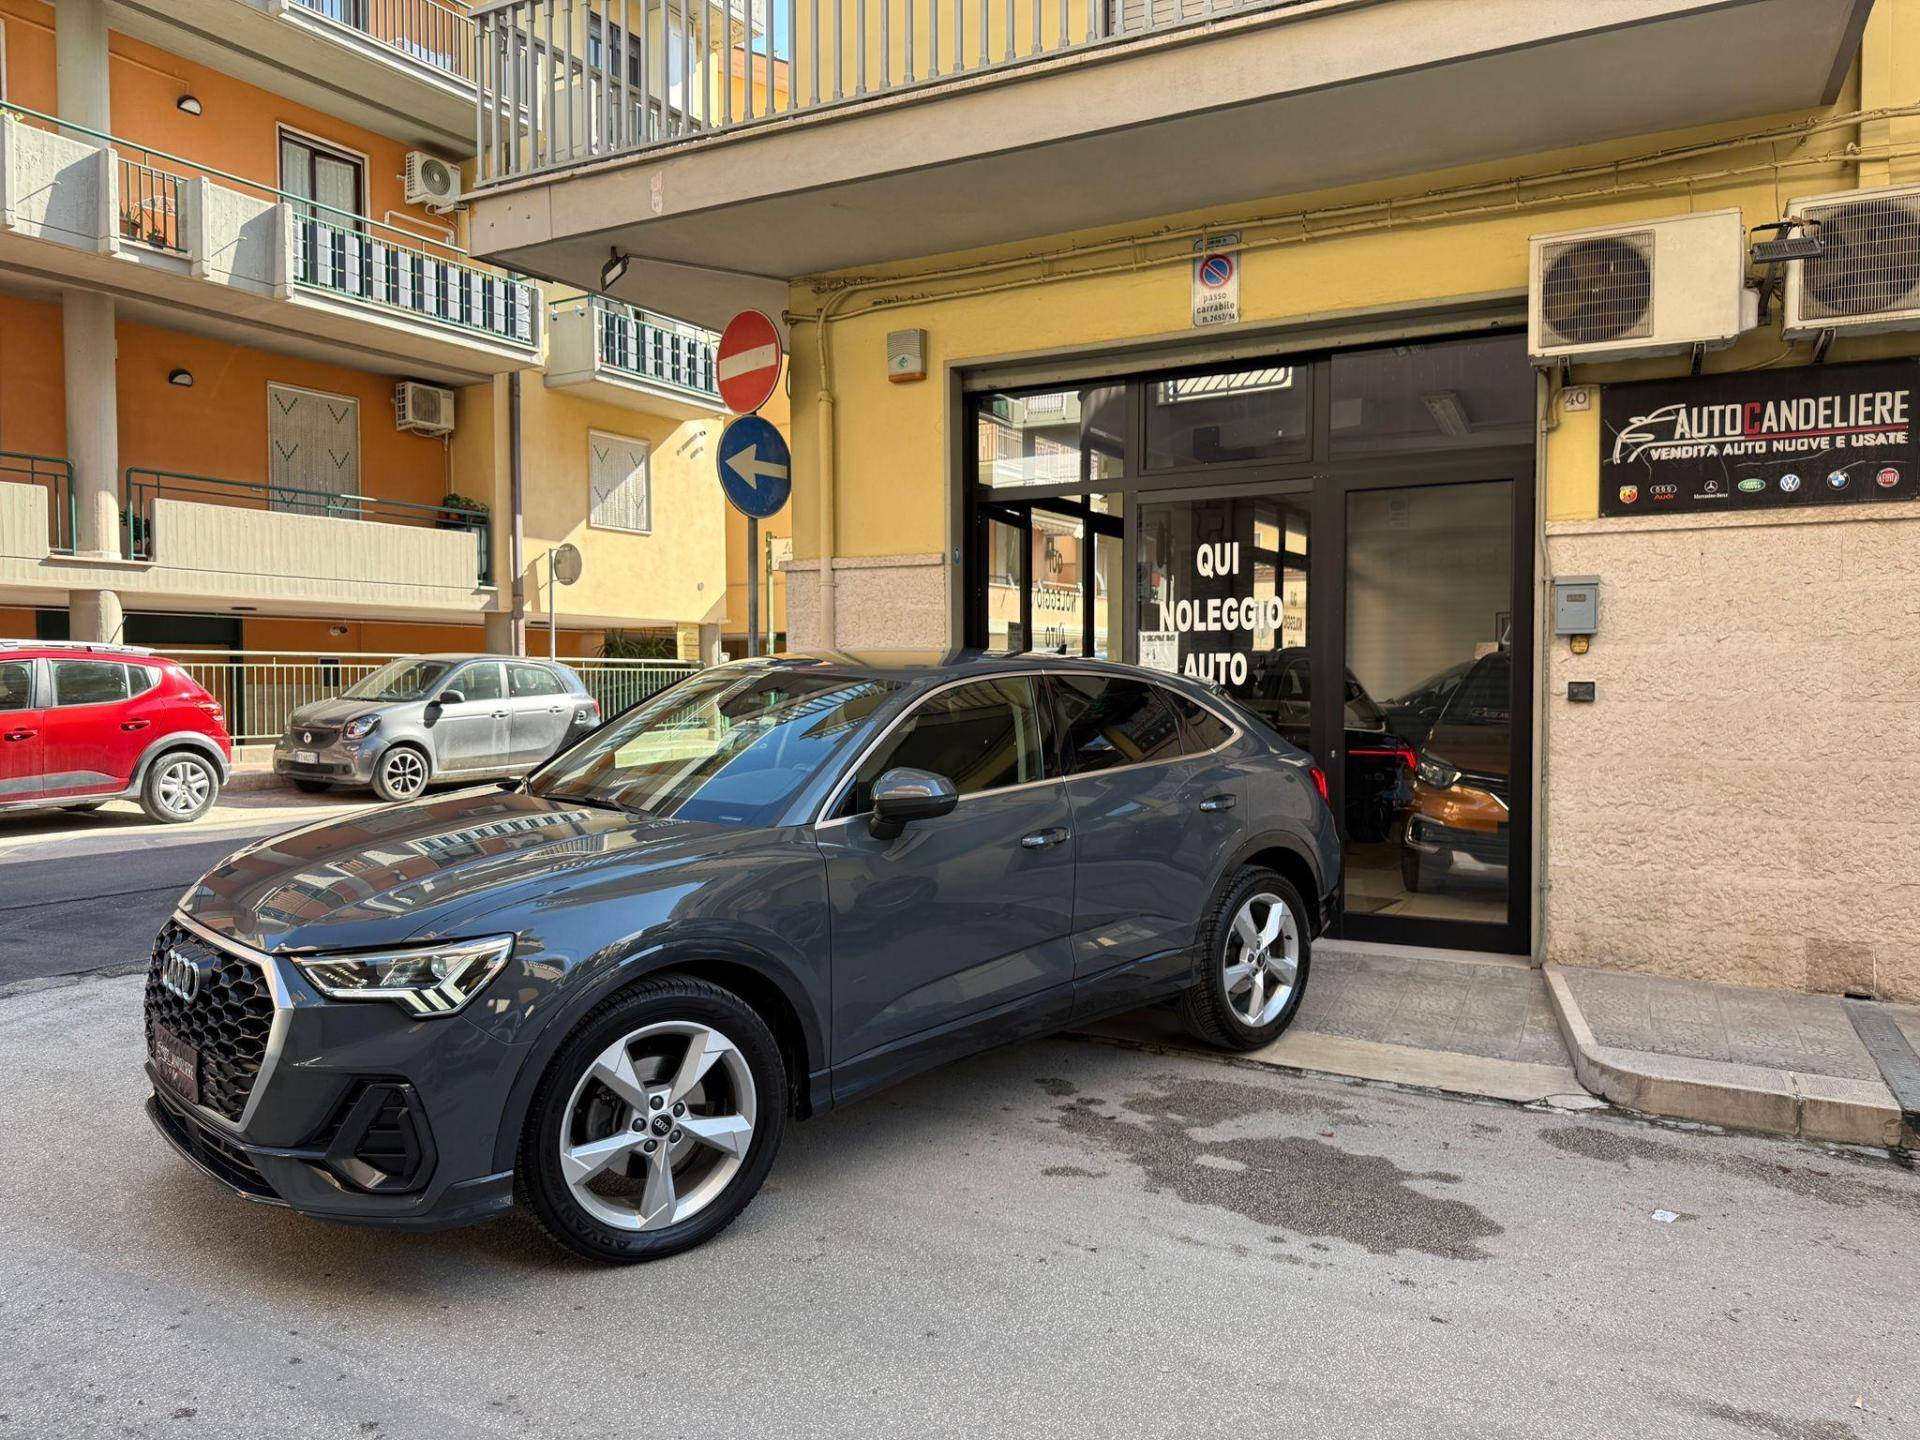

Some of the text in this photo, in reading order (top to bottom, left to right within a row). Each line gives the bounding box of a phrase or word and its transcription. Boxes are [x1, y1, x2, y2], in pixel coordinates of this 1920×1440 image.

[1204, 292, 1227, 304] passo
[1564, 391, 1587, 405] 40
[1674, 390, 1910, 439] AUTOCANDELIERE
[1650, 431, 1909, 461] VENDITA AUTO NUOVE E USATE
[1196, 542, 1239, 579] QUI
[1159, 596, 1284, 633] NOLEGGIO
[1184, 652, 1248, 686] AUTO
